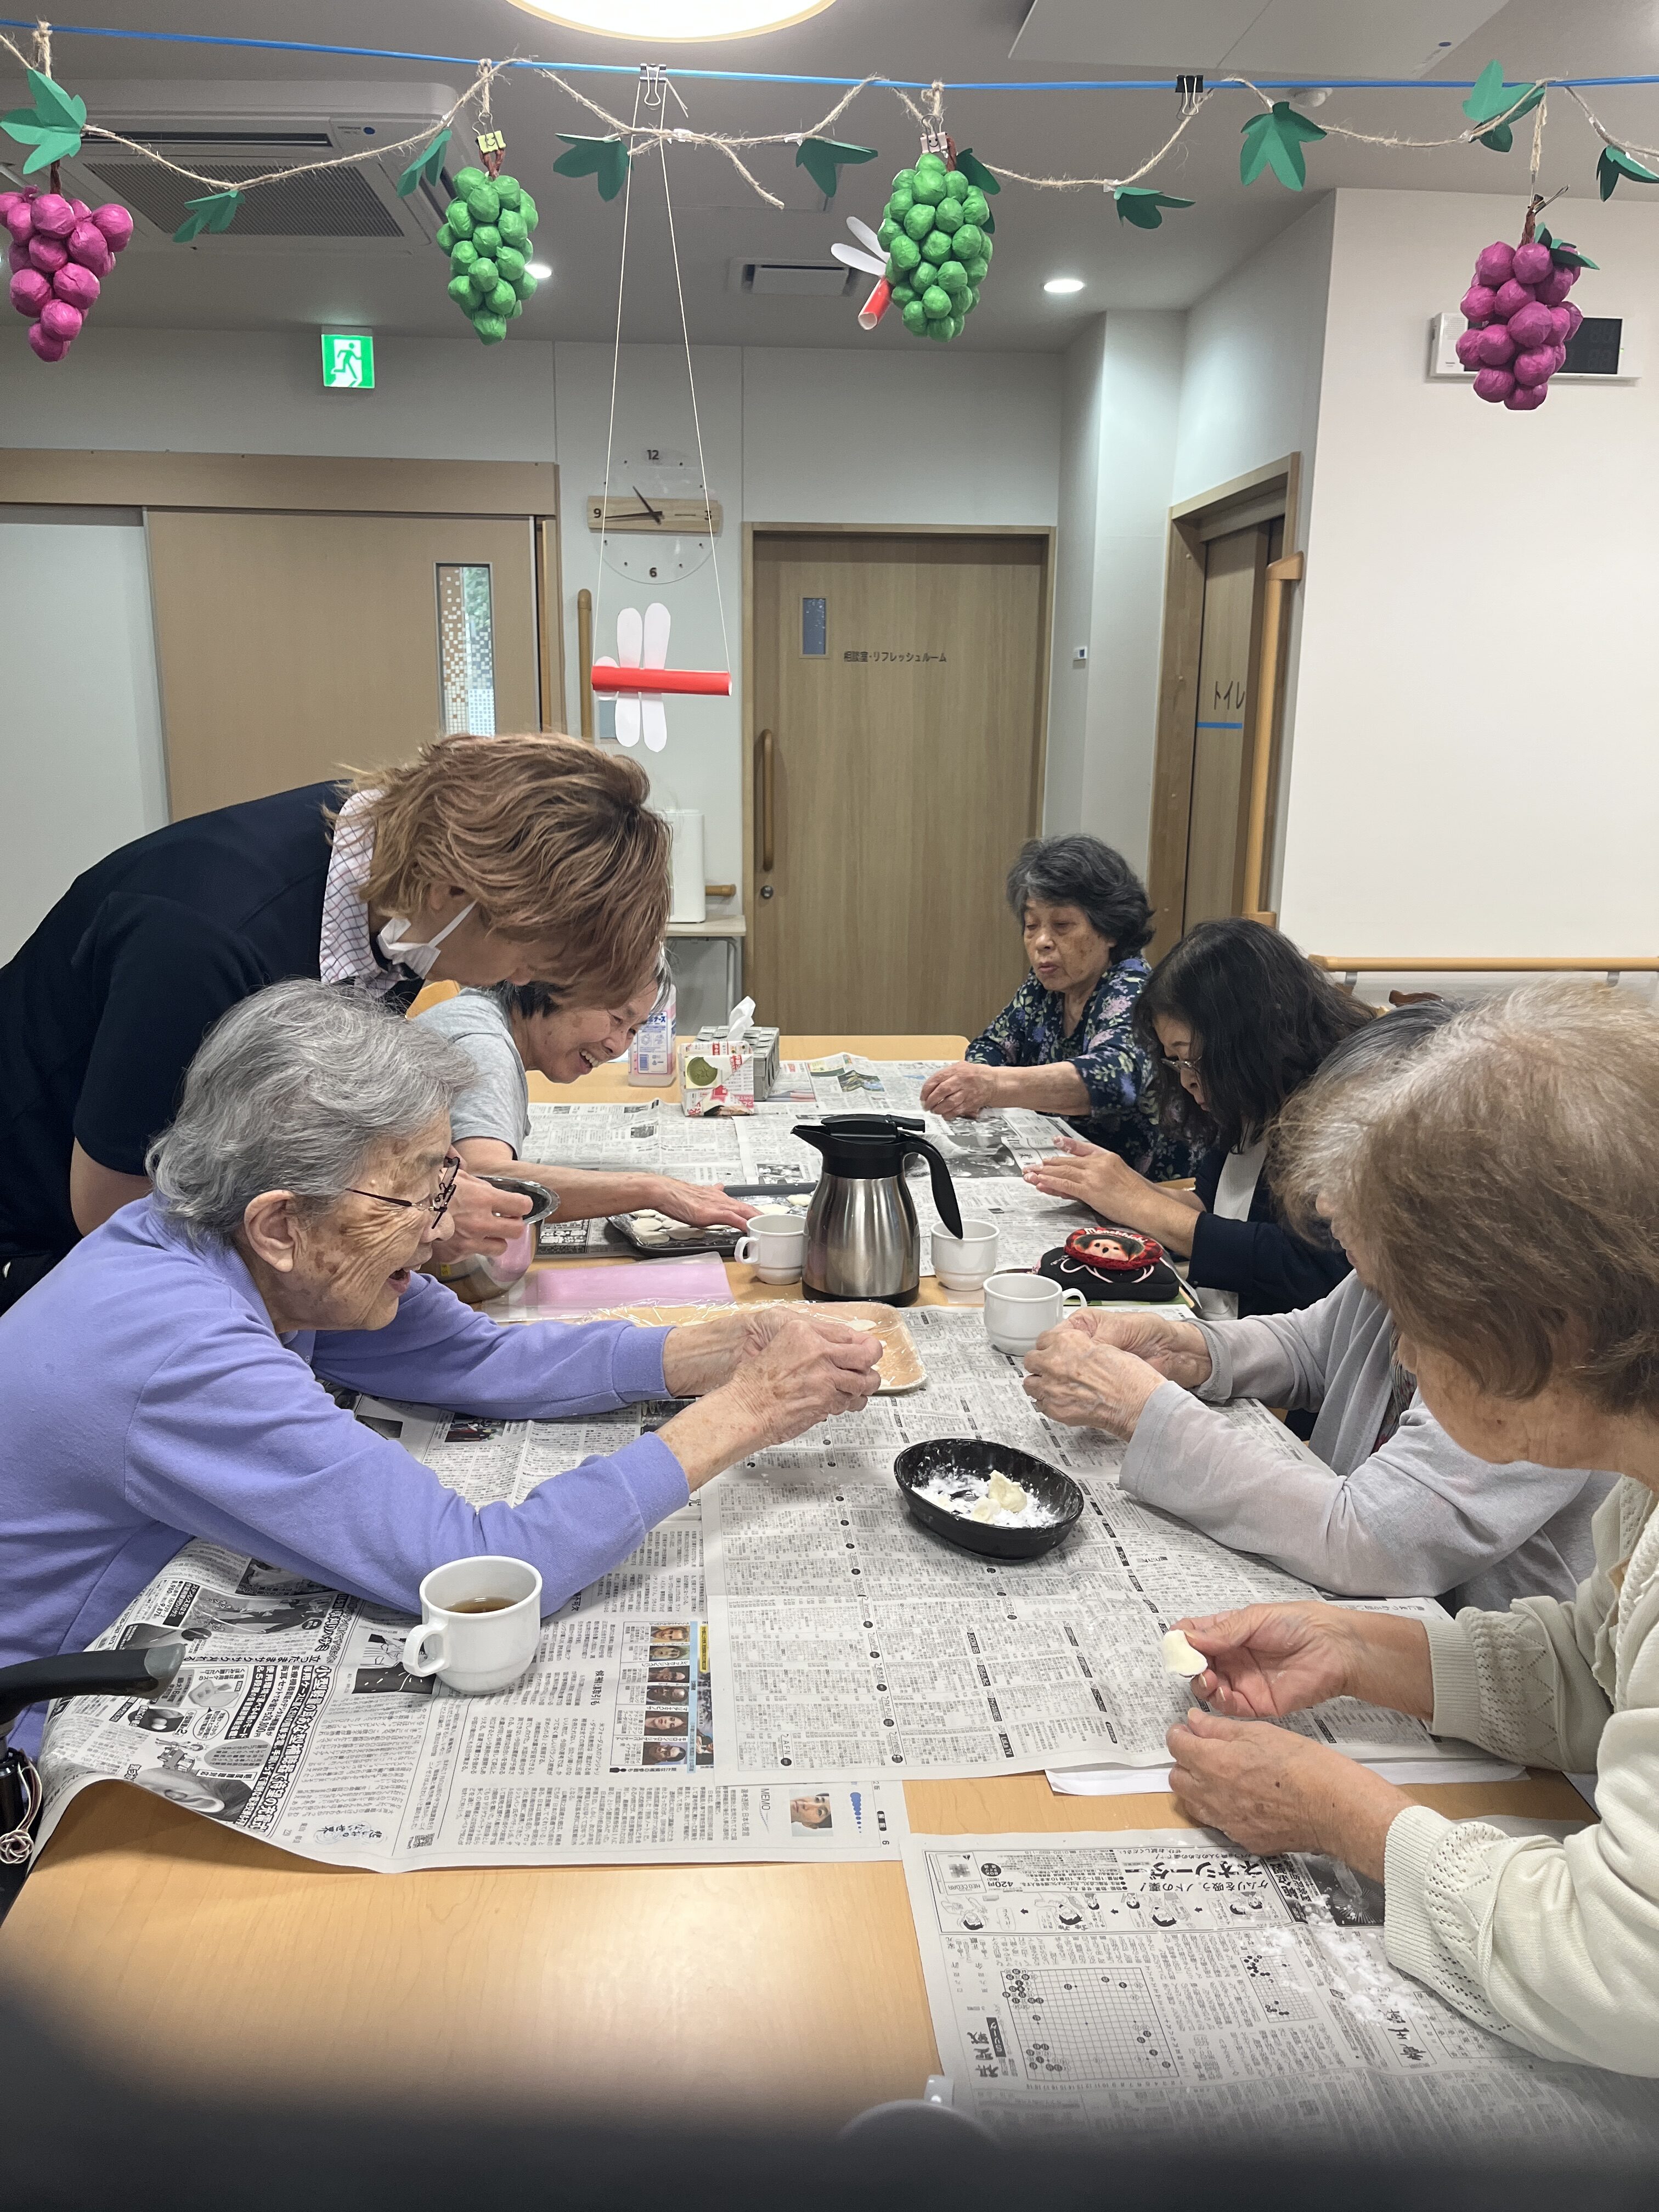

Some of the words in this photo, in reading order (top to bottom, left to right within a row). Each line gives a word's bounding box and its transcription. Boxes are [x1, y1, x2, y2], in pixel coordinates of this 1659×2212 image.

[647, 449, 659, 460] 12
[594, 508, 601, 518] 9
[650, 567, 657, 578] 6
[1214, 680, 1245, 710] トイレ
[783, 1740, 791, 1755] AFN
[760, 1788, 771, 1810] MEMO
[1125, 1860, 1262, 1881] ネオシーダー
